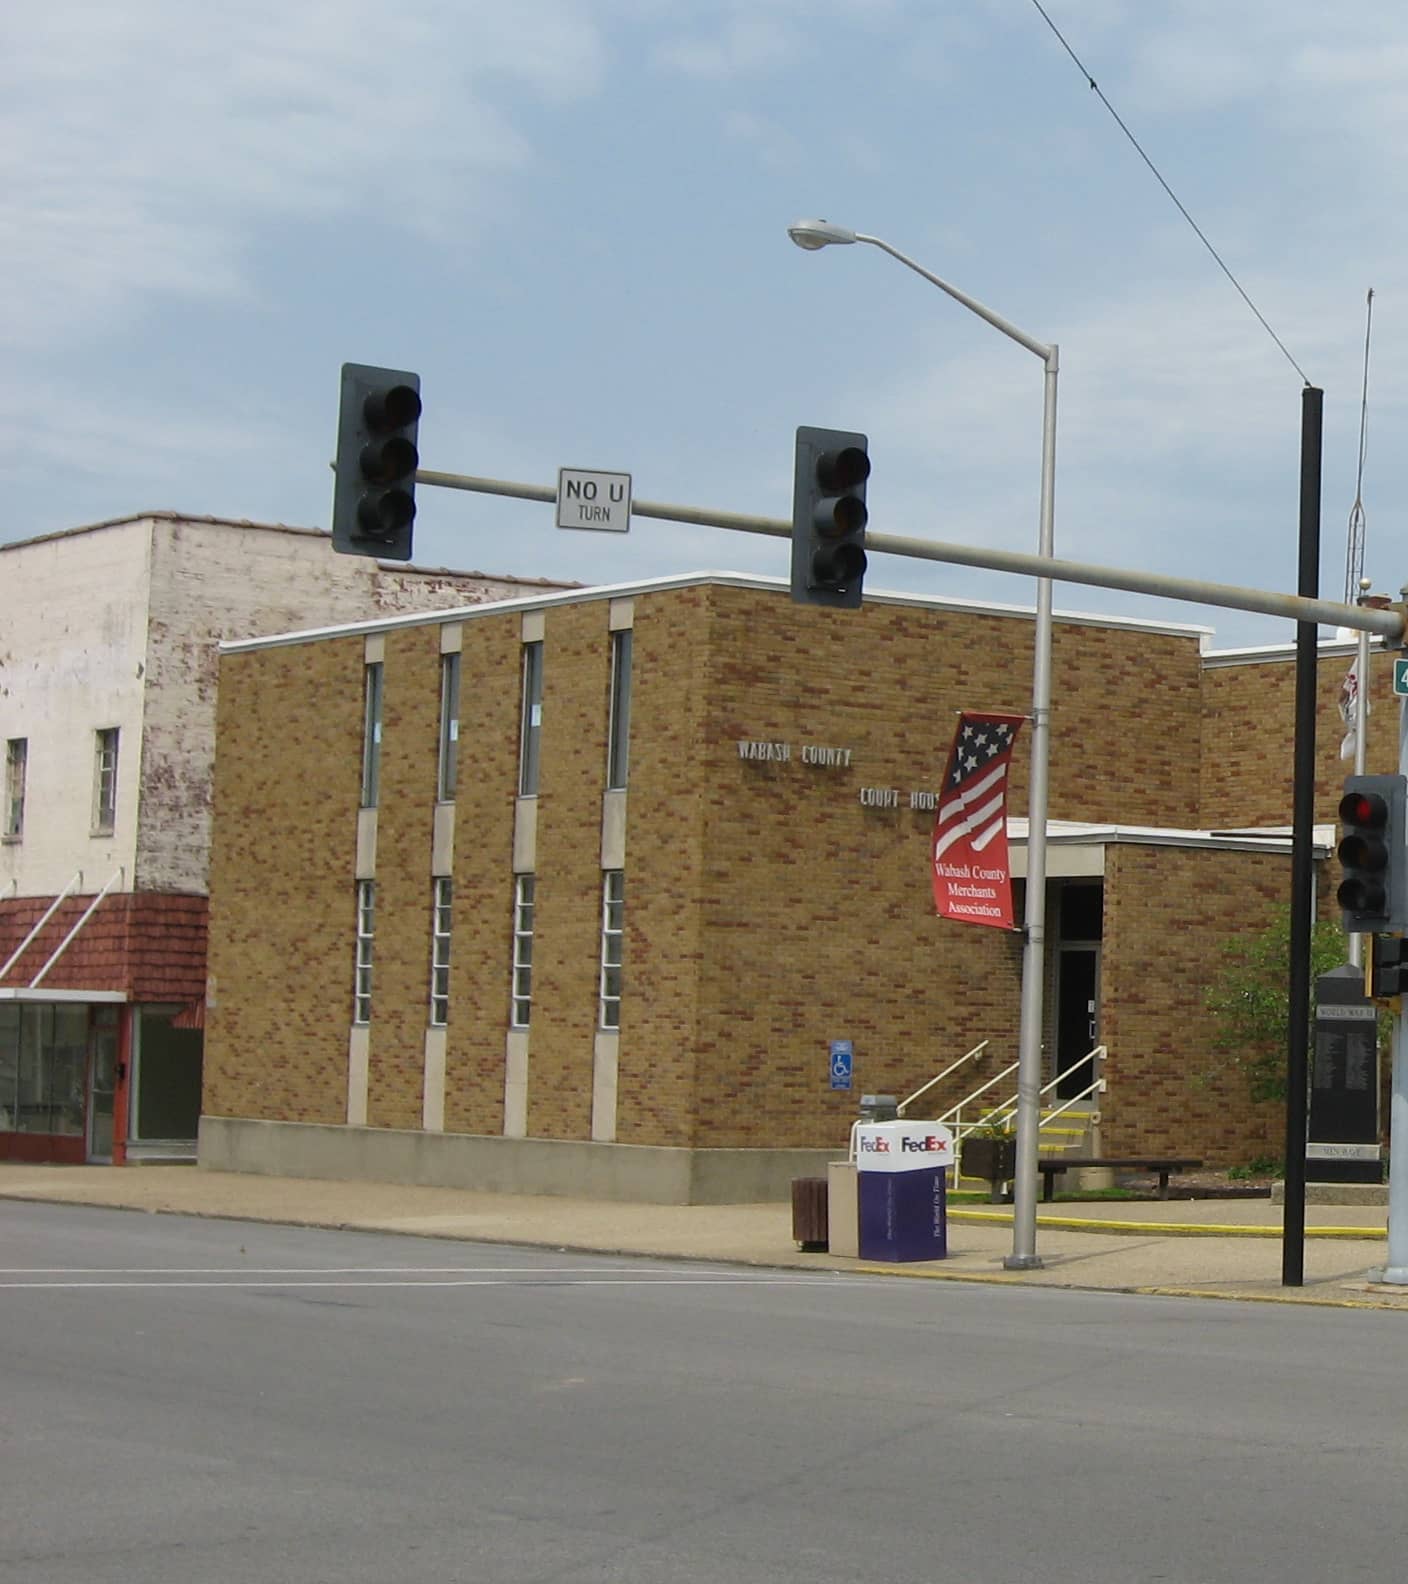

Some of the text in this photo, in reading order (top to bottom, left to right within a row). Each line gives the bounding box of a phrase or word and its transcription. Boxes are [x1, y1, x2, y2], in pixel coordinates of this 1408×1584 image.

[567, 480, 623, 502] NO U
[579, 505, 610, 521] TURN
[737, 741, 851, 766] WABASH COUNTY
[860, 787, 940, 810] COURT HOUS
[935, 863, 1006, 883] Wabash County
[948, 882, 996, 898] Merchants
[949, 901, 1002, 917] Association
[860, 1135, 890, 1152] FedEx
[902, 1135, 947, 1152] FedEx
